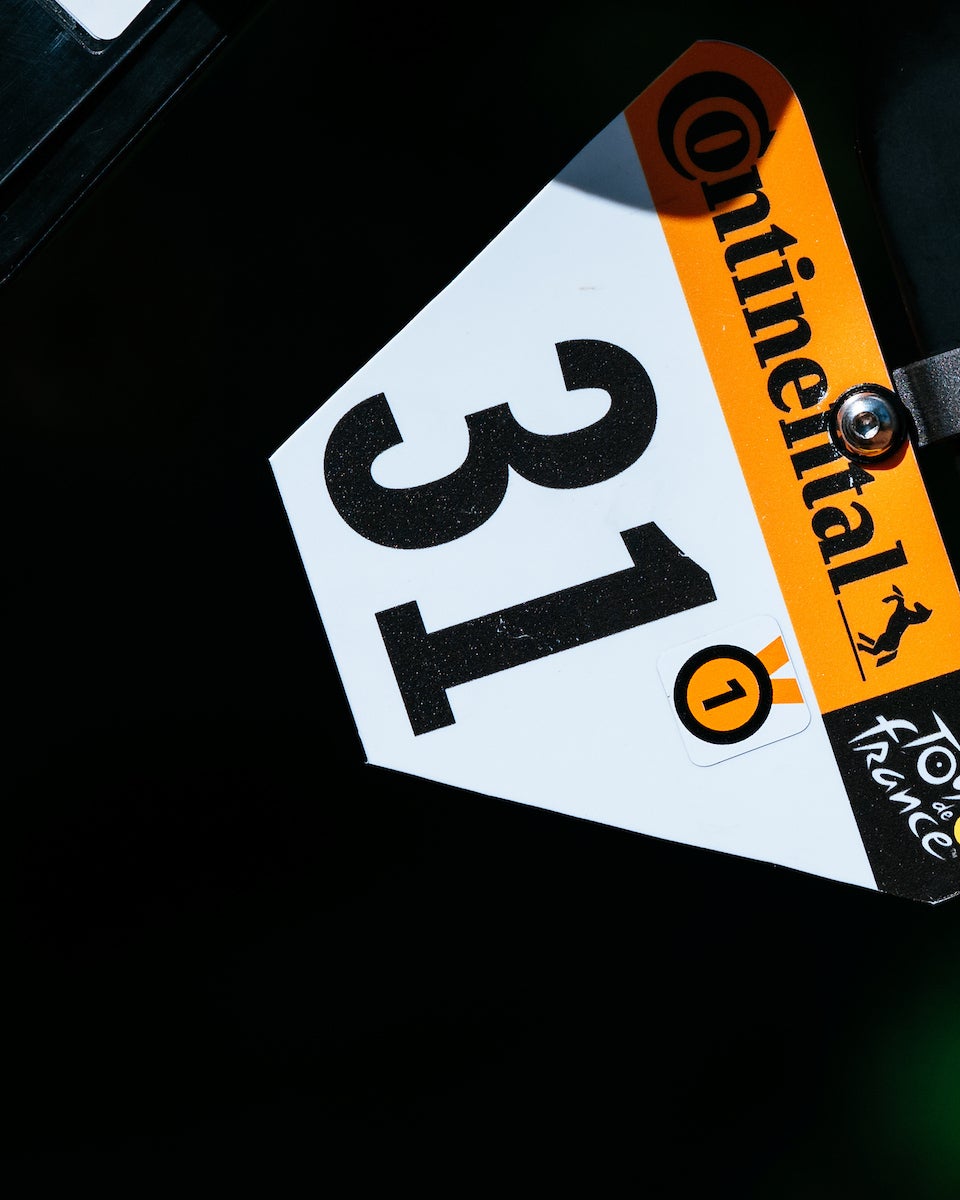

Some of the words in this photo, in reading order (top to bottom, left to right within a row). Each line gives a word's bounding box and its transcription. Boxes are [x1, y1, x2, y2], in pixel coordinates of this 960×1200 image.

[657, 70, 908, 596] Continental
[323, 338, 718, 737] 31
[702, 678, 747, 711] 1
[932, 802, 955, 820] de
